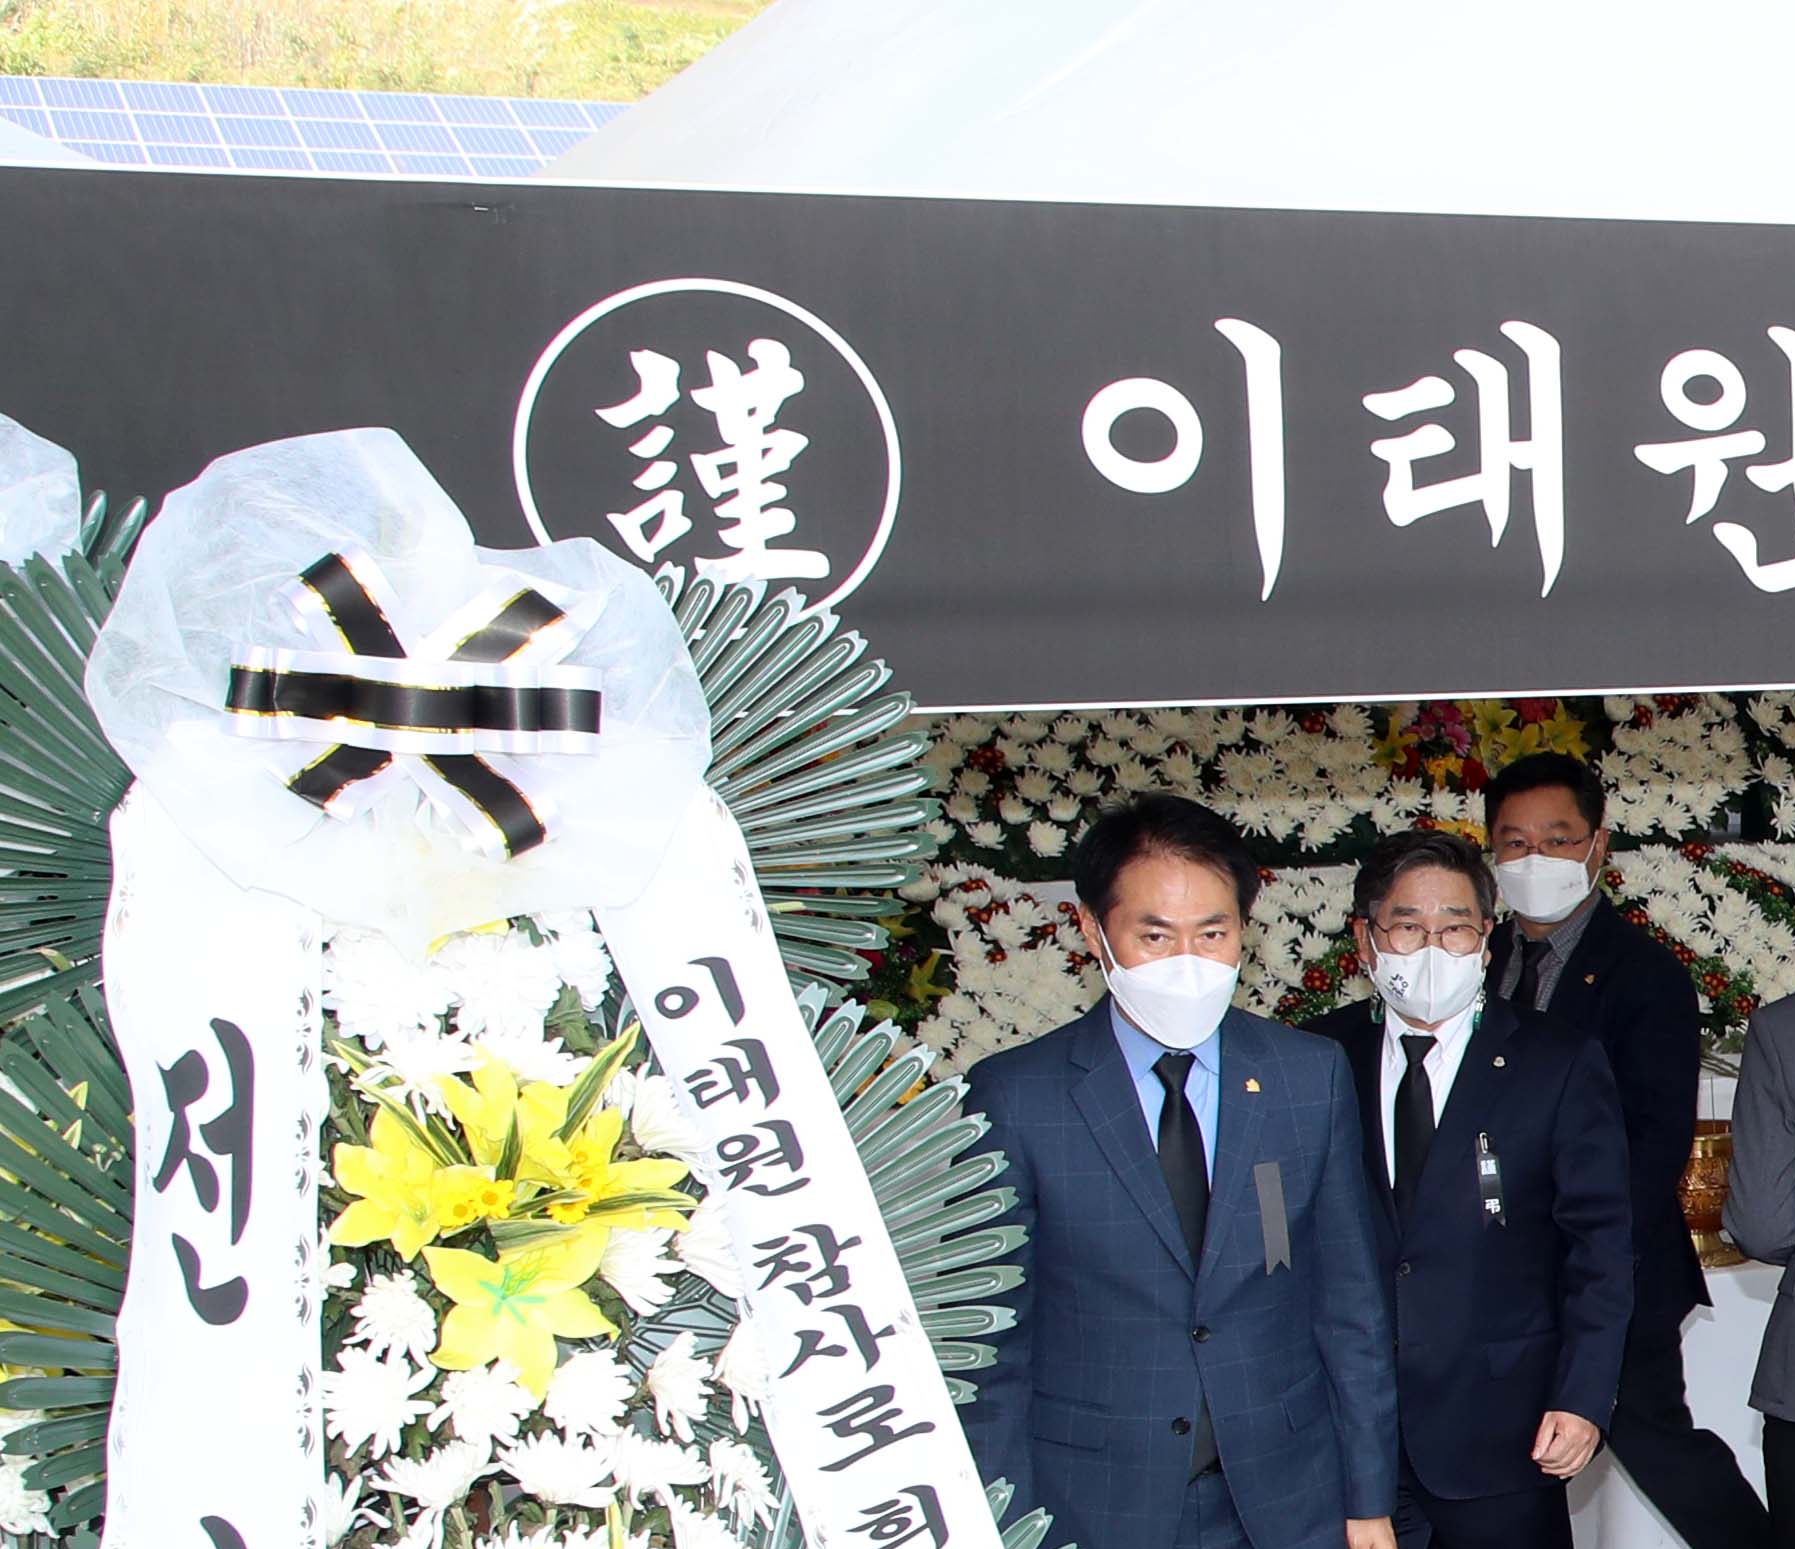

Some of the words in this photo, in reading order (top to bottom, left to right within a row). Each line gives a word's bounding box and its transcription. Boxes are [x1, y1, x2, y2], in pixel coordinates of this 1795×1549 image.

[594, 337, 832, 581] 謹
[654, 955, 811, 1196] 이태원
[753, 1222, 936, 1473] 참사로
